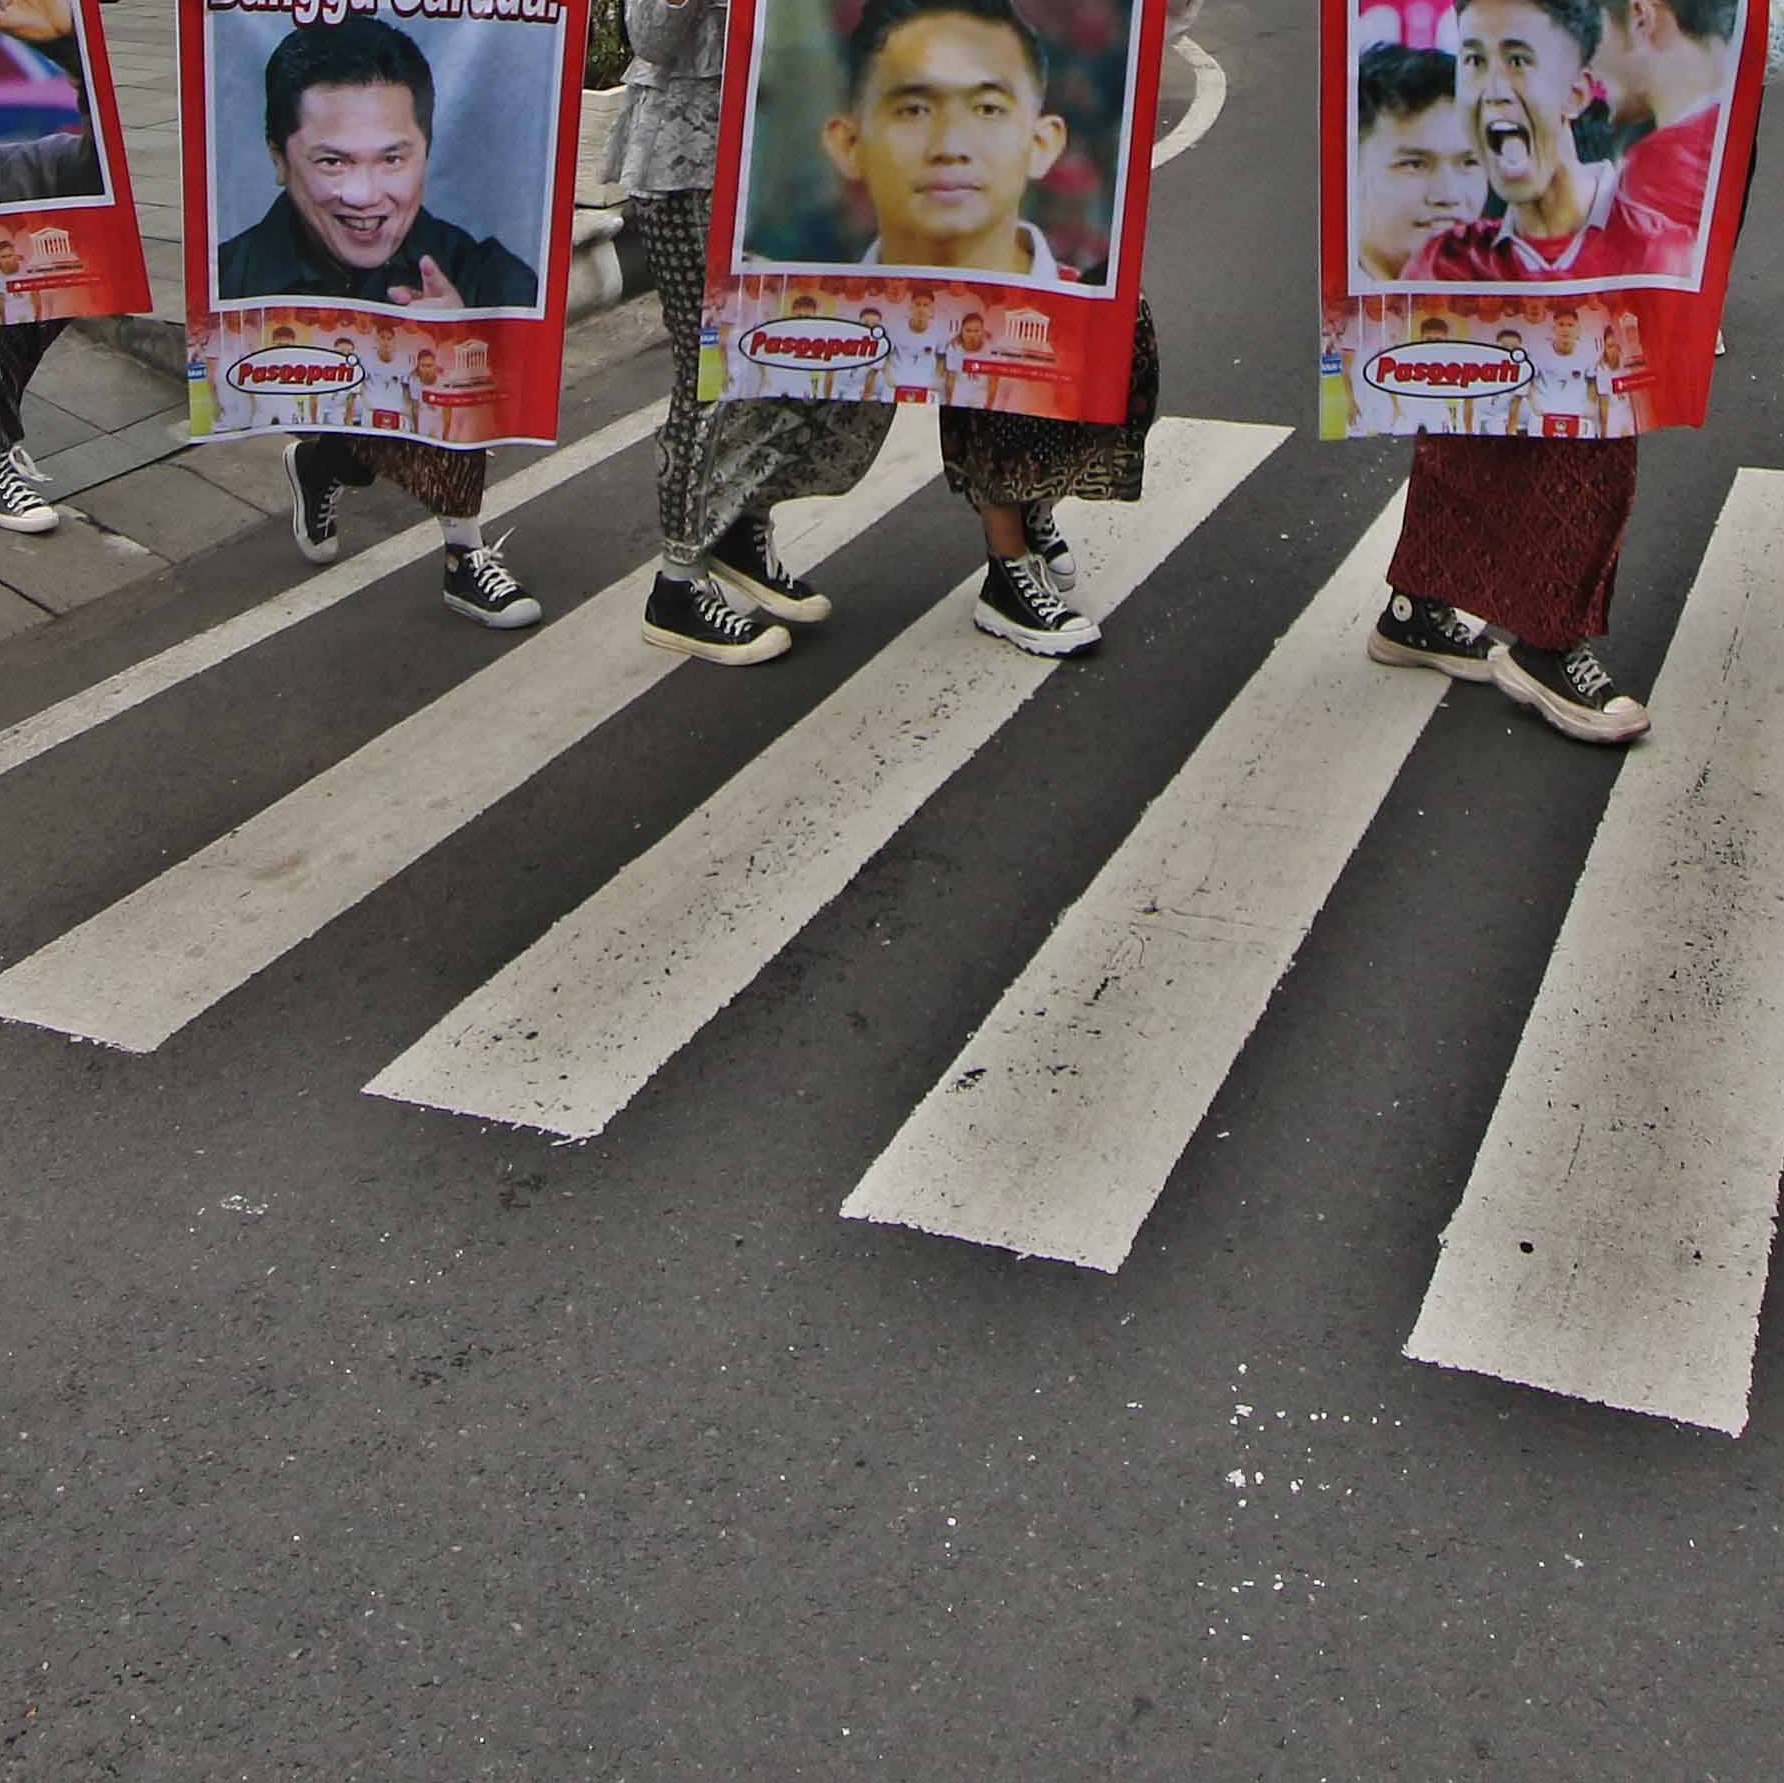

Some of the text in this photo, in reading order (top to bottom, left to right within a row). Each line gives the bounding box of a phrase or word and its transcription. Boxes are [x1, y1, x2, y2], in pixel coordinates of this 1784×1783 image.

[749, 330, 881, 362] Pasoepati
[237, 362, 355, 387] Pasoepati
[1375, 356, 1521, 388] Pasoepati
